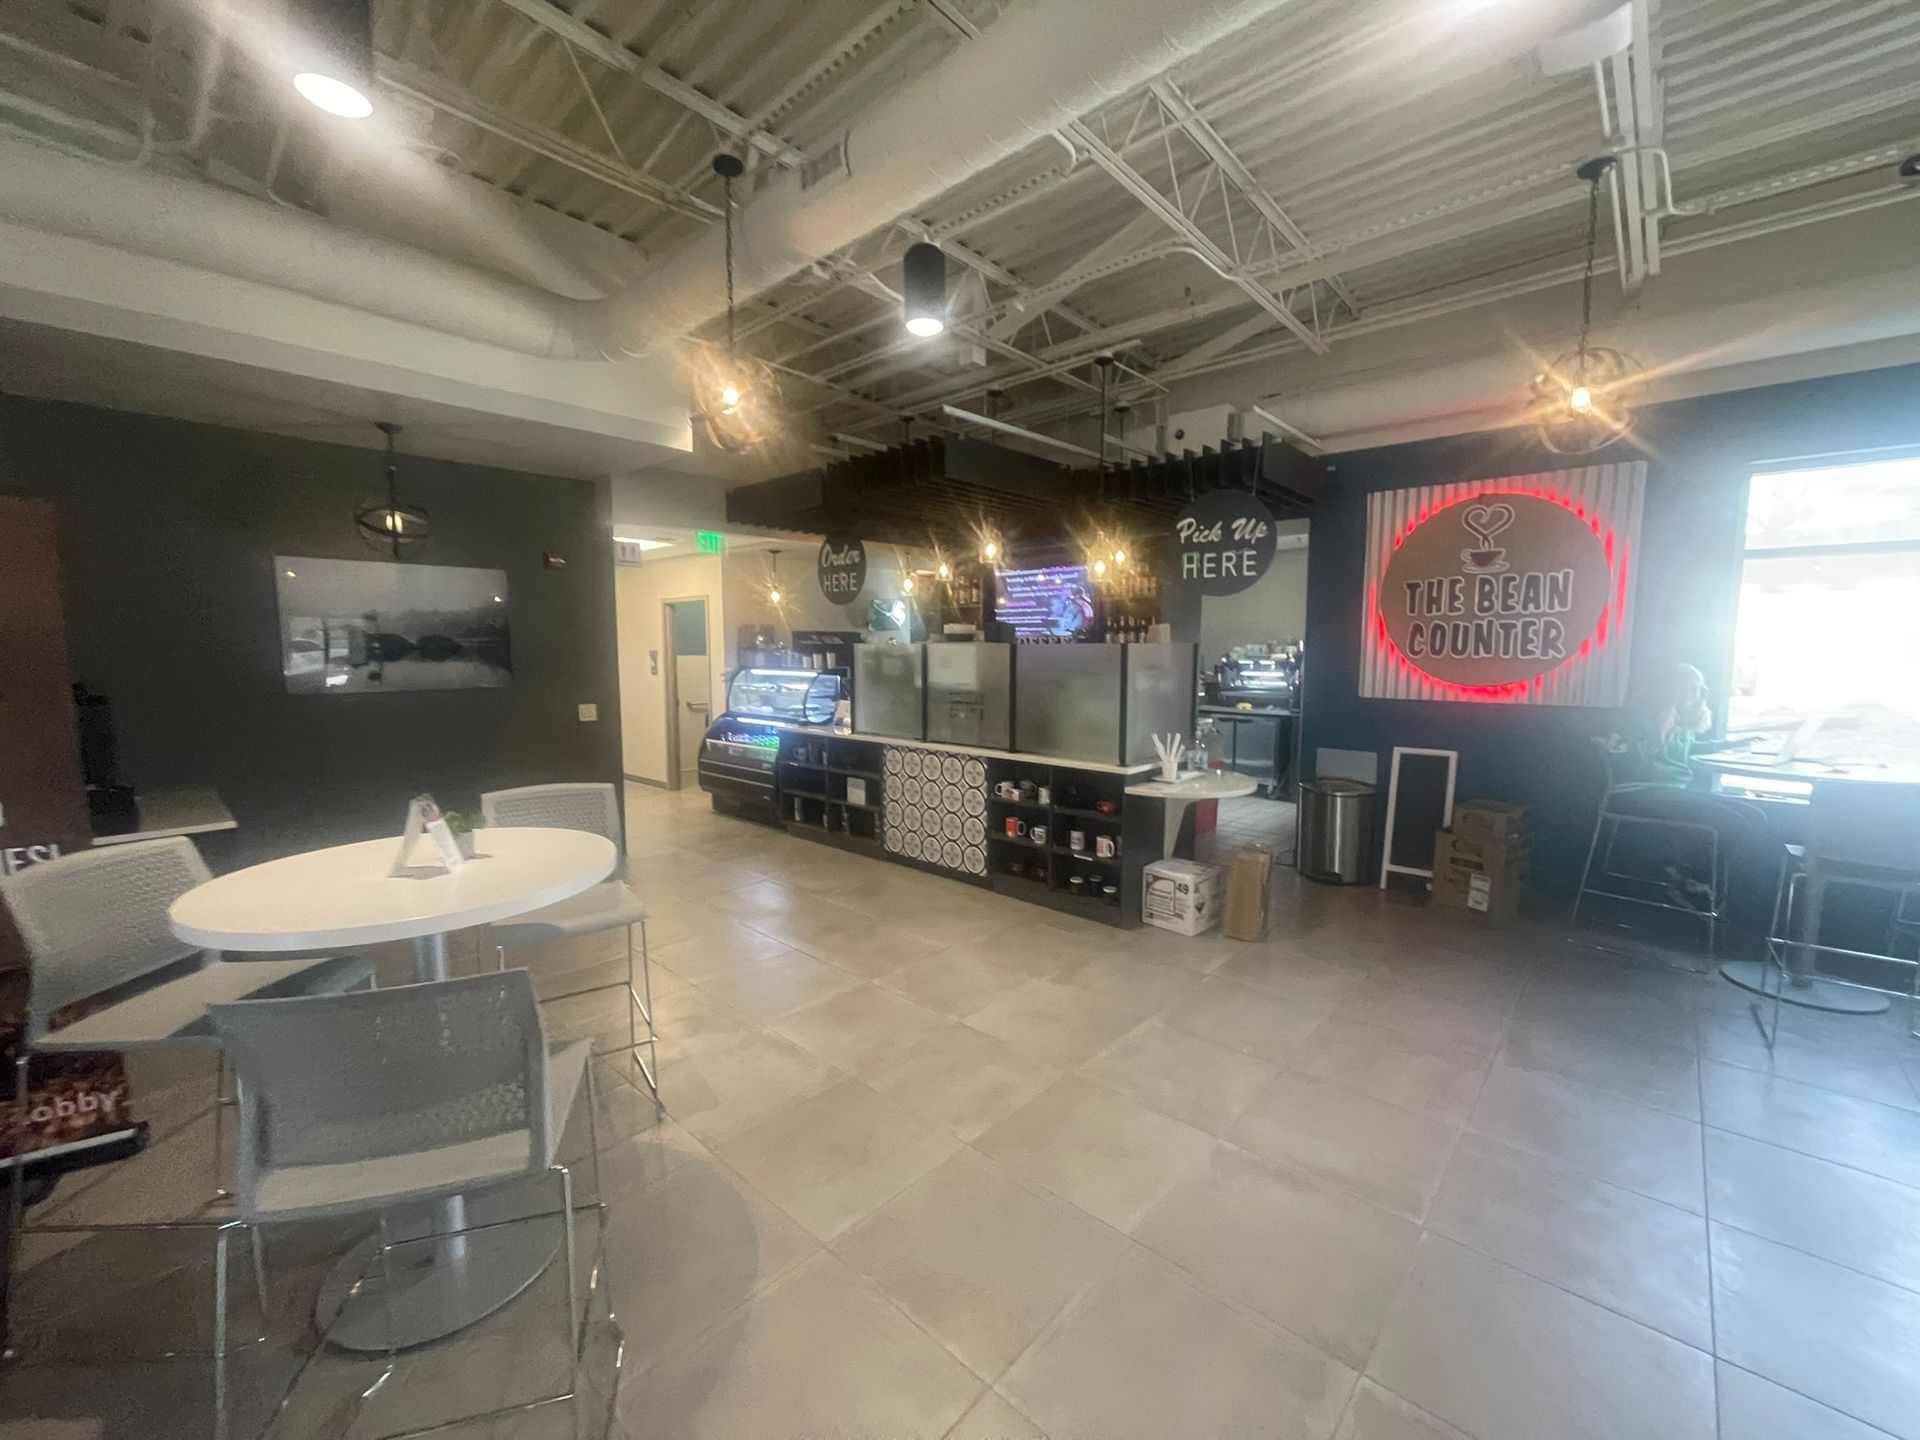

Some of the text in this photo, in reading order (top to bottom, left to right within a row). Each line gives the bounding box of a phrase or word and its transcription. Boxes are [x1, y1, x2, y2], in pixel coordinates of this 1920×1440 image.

[1176, 517, 1269, 545] Pick Up
[821, 542, 860, 568] Order
[1183, 549, 1257, 579] HERE
[823, 572, 858, 593] HERE
[1404, 568, 1574, 616] THE BEAN
[1406, 617, 1566, 659] COUNTER
[1176, 883, 1189, 895] 49
